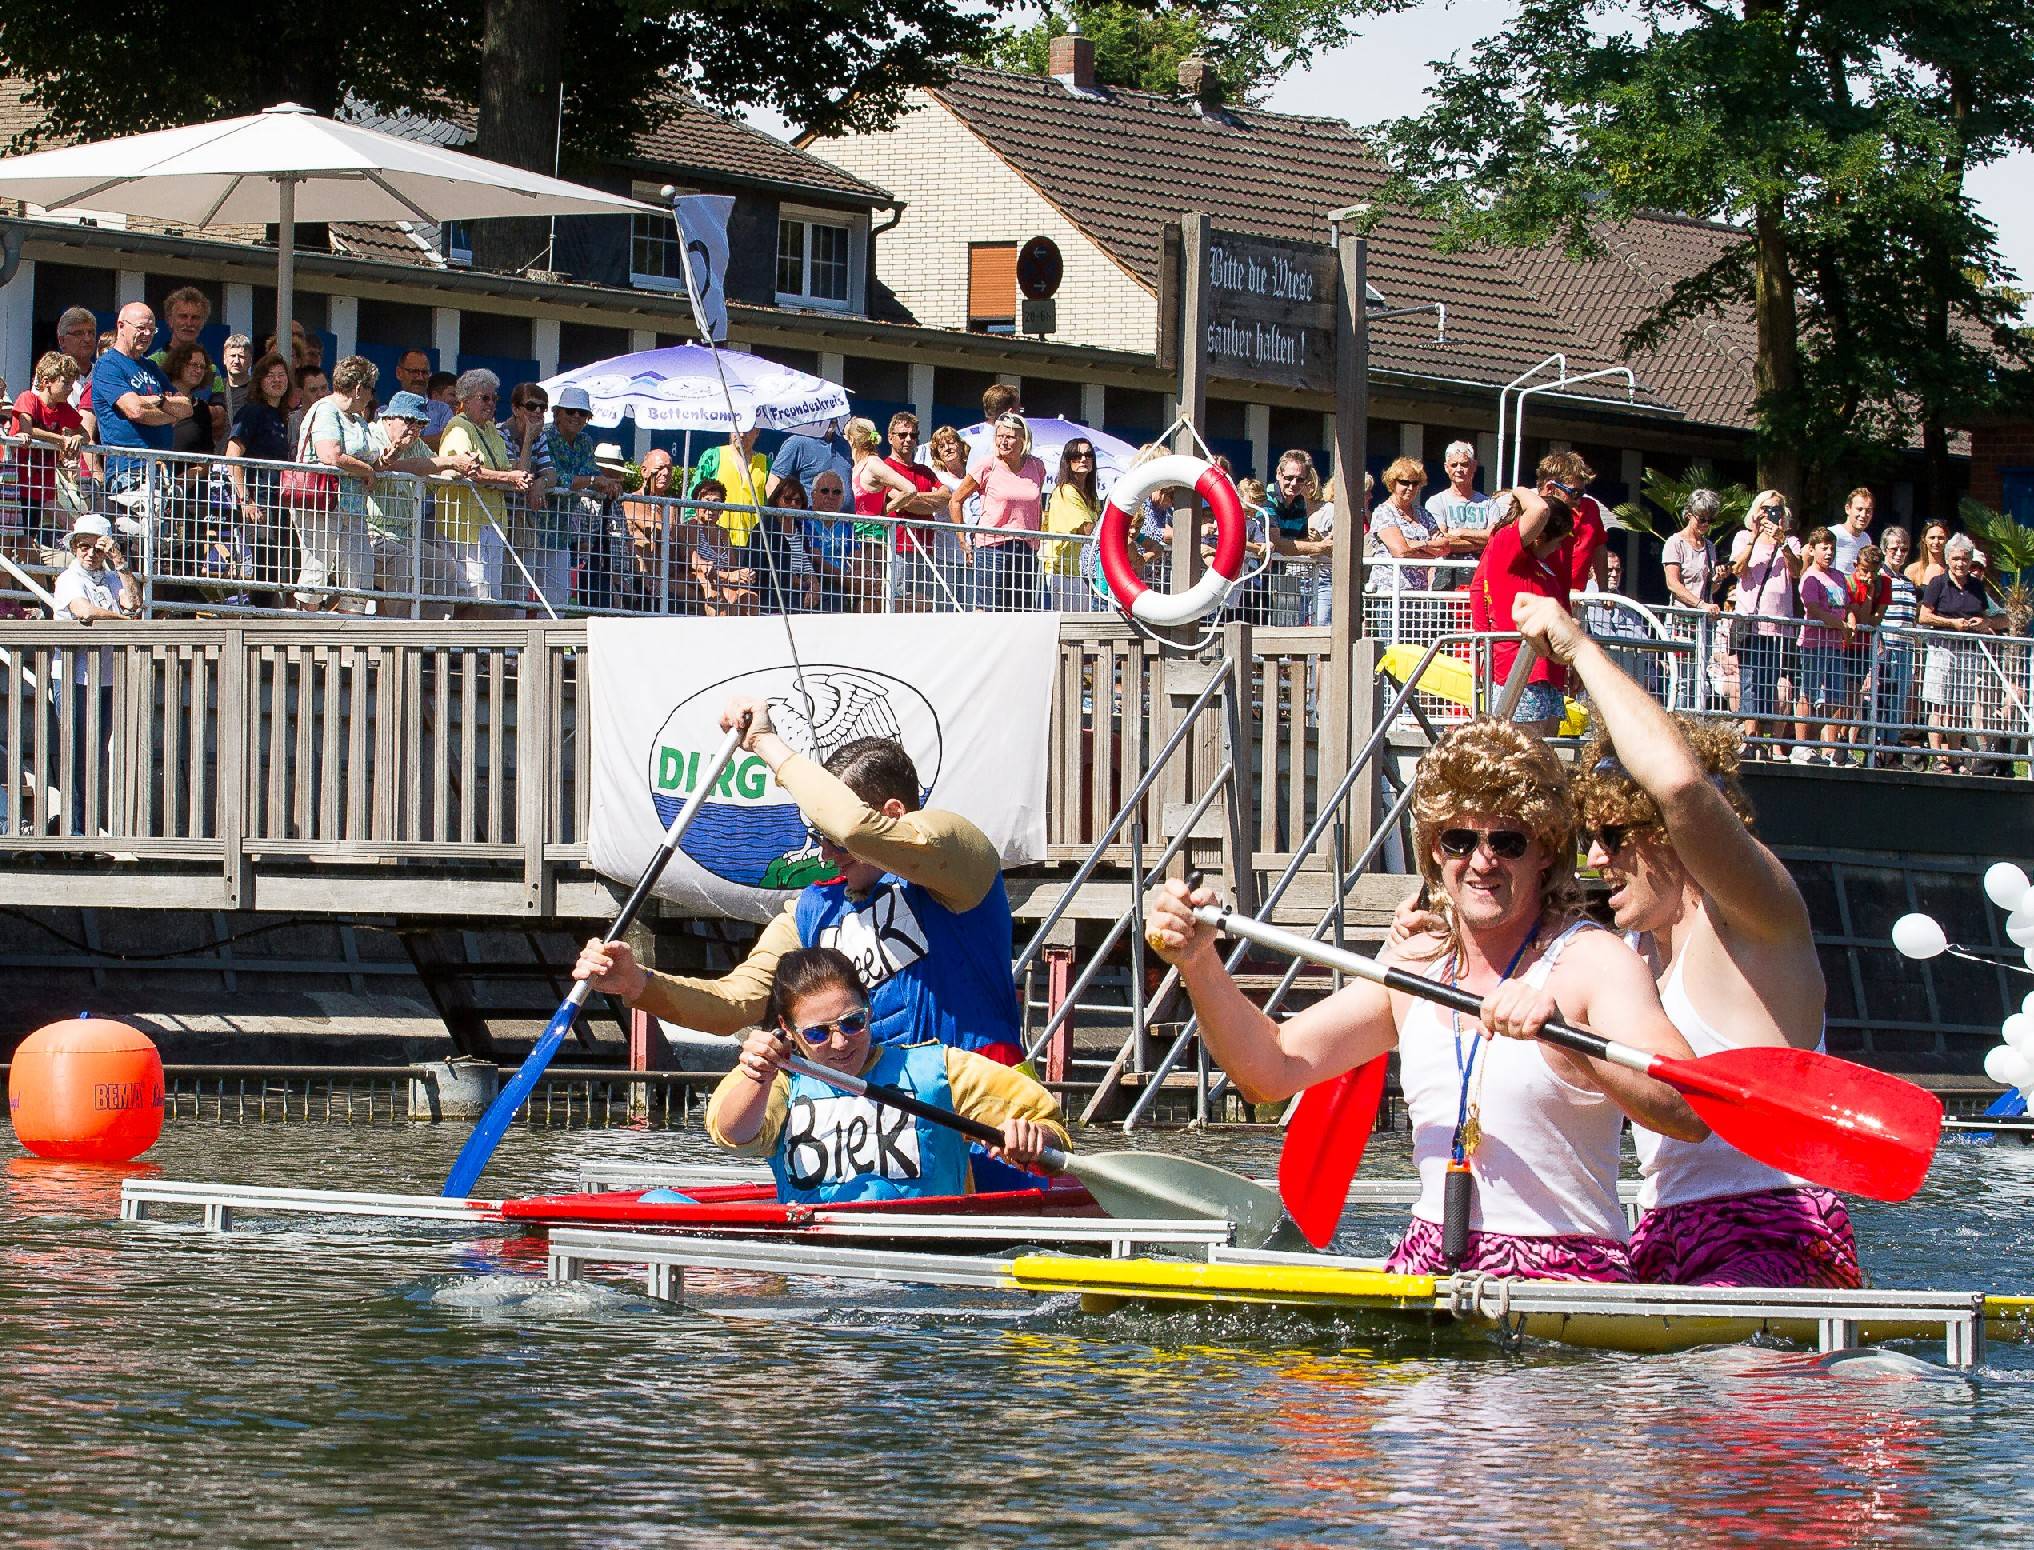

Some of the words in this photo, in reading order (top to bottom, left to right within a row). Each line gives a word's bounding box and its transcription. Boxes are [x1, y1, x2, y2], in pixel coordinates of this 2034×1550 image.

[1210, 246, 1245, 291] Bitte
[1248, 256, 1267, 294] die
[1272, 255, 1313, 302] Wiese
[1207, 319, 1252, 358] sauber
[1448, 505, 1486, 522] LOST
[95, 1083, 144, 1110] BEMA
